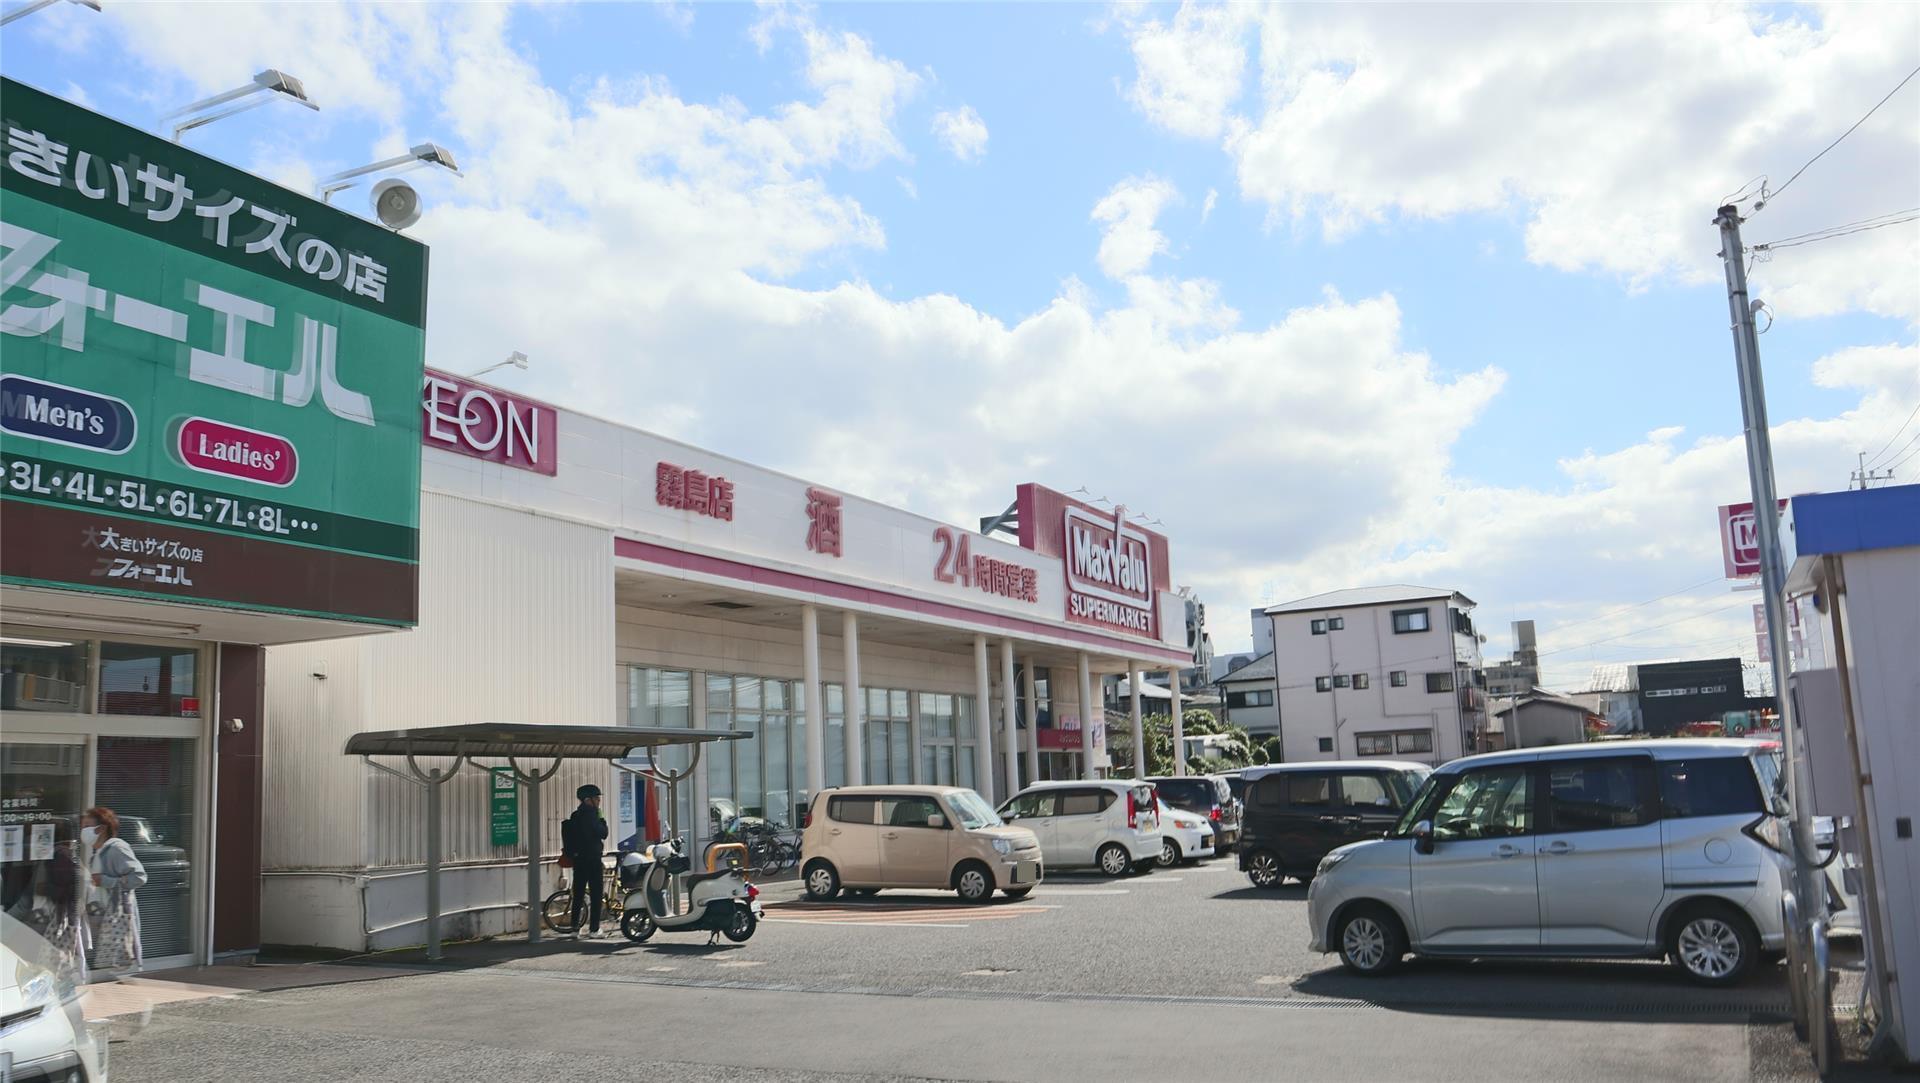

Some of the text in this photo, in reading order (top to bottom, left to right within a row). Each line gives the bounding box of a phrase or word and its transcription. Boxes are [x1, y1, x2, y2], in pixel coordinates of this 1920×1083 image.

[24, 394, 105, 436] Men's
[199, 432, 281, 471] Ladies'
[656, 461, 735, 522] 霧島店
[805, 486, 843, 558] 酒
[100, 526, 204, 563] 大きいサイズの店
[1073, 505, 1145, 593] MaxValu
[1070, 593, 1152, 632] SUPERMARKET
